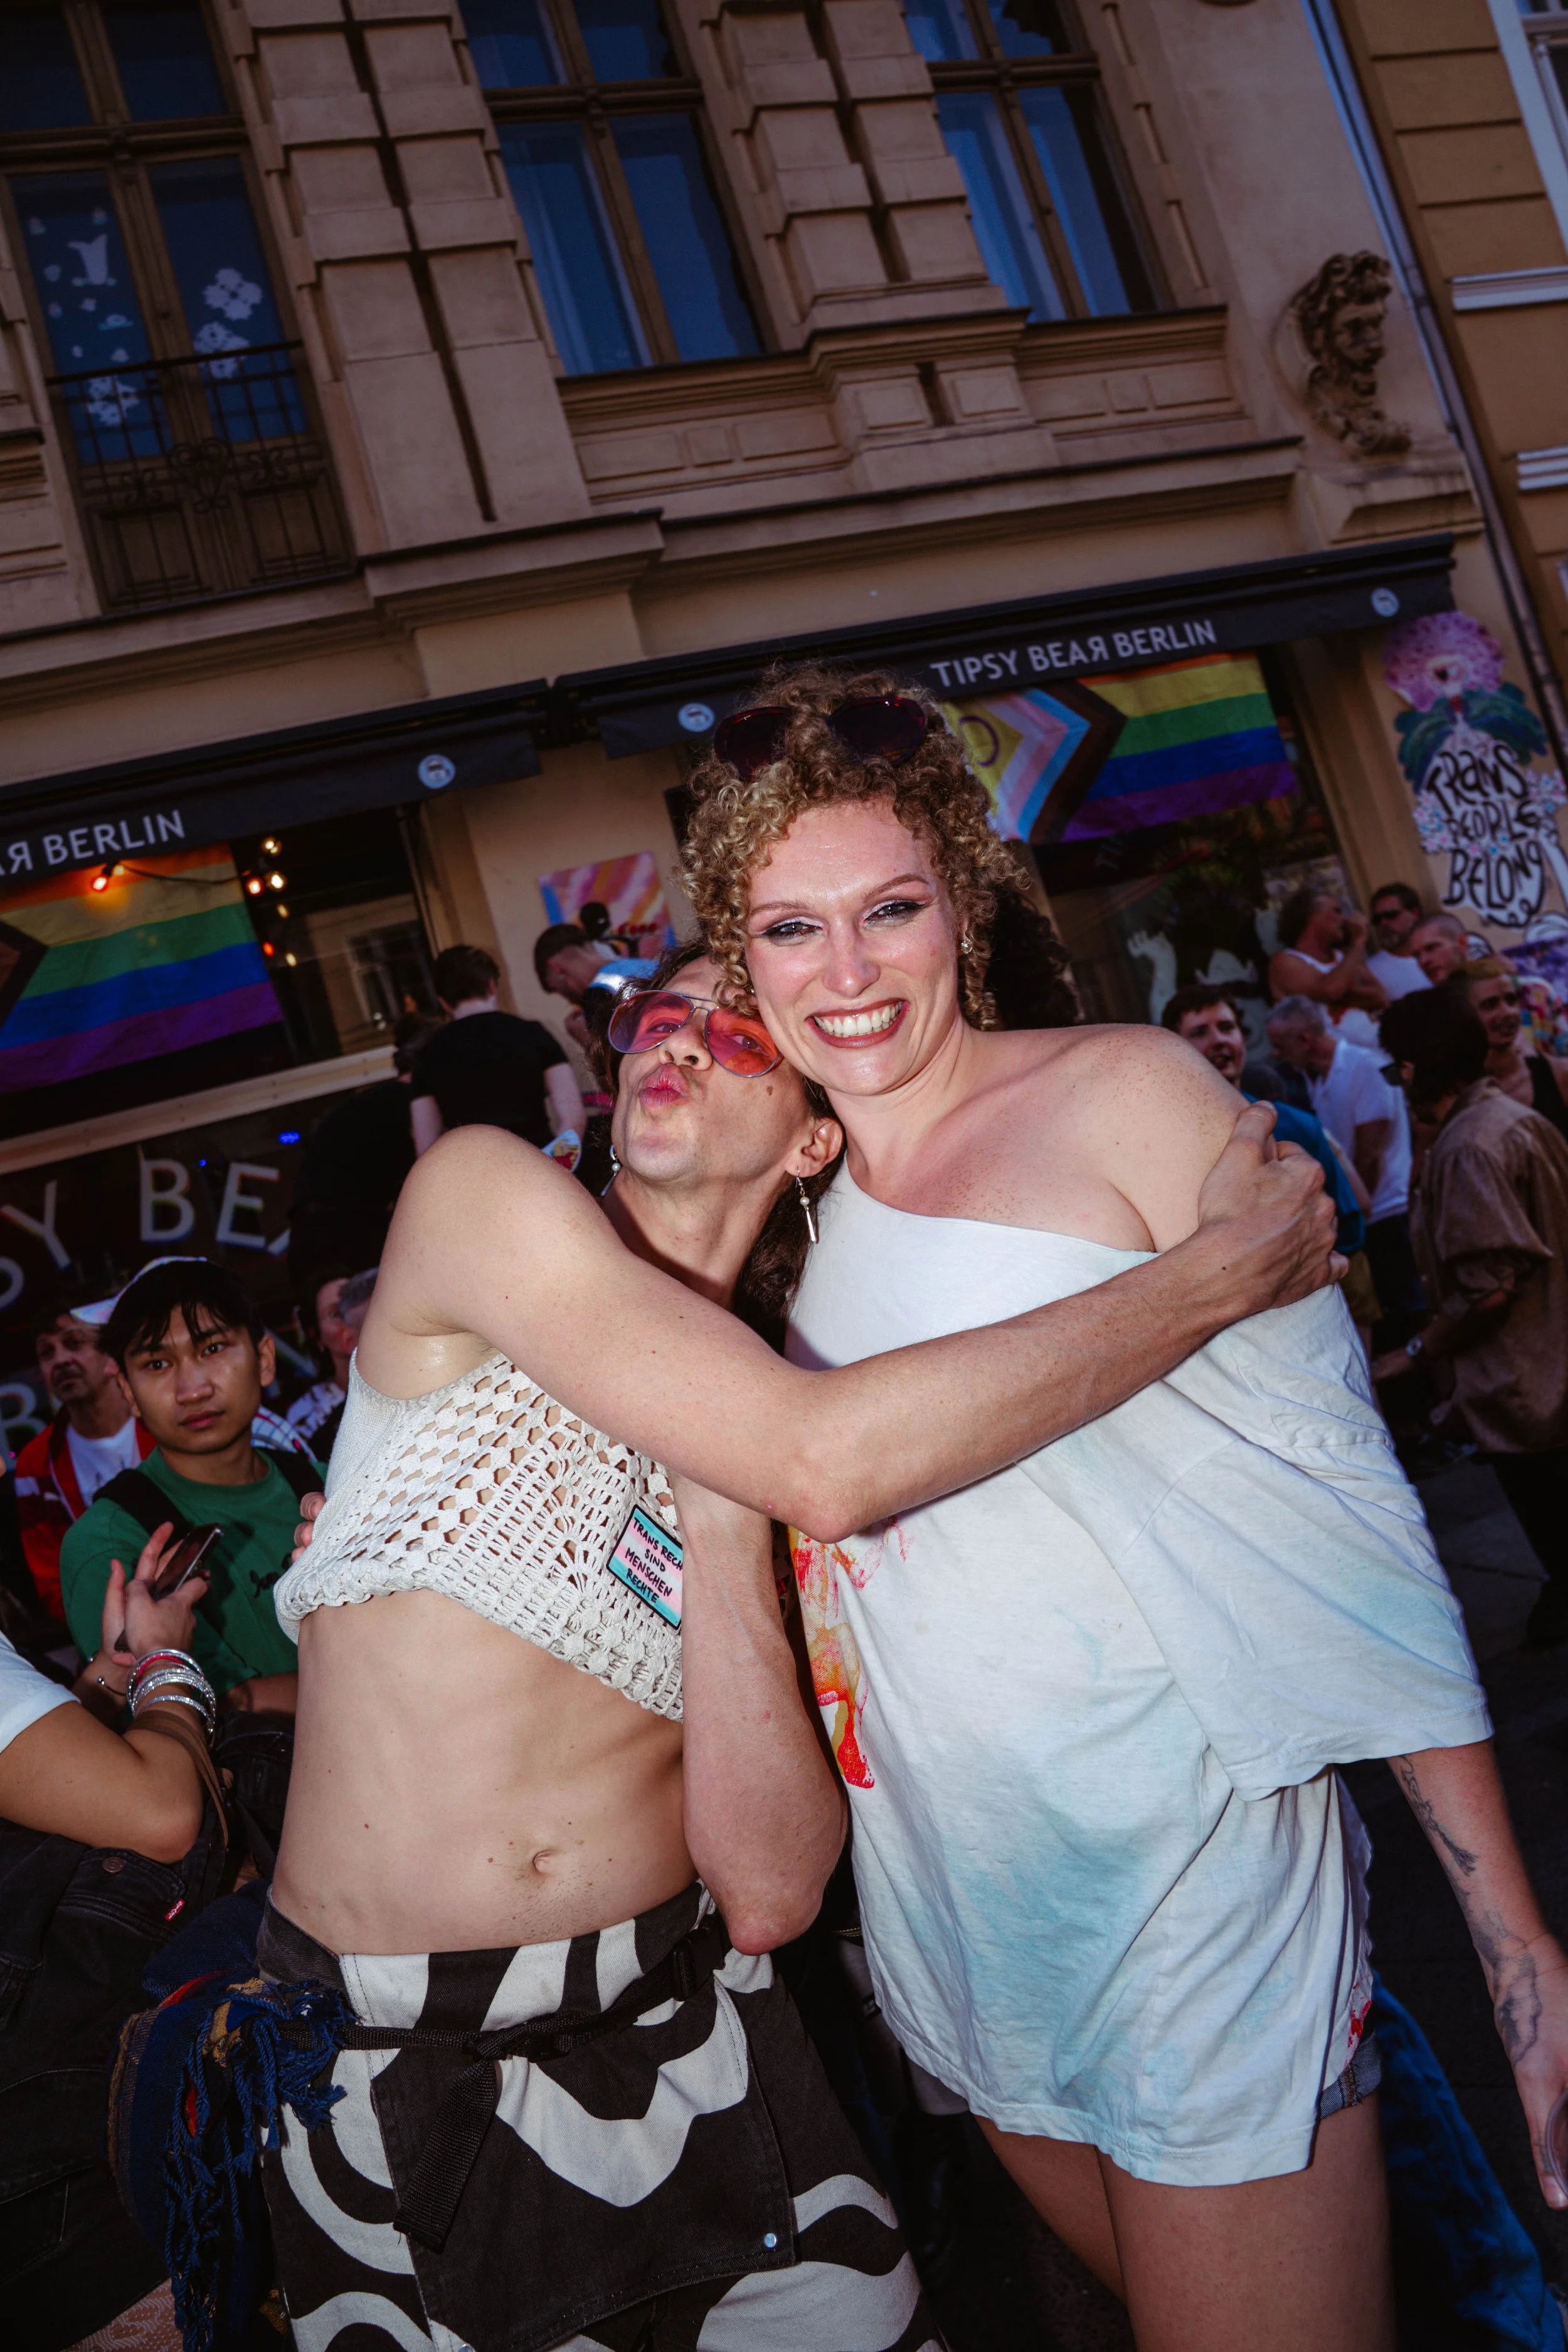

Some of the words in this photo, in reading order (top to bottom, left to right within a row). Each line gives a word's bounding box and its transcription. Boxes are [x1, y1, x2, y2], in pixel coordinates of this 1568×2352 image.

[930, 649, 1019, 688] TIPSY
[1111, 618, 1218, 659] BERLIN
[41, 808, 186, 866] BERLIN
[633, 1516, 659, 1550] TRANS
[625, 1546, 673, 1597] MENSCHEN
[644, 1548, 666, 1572] SIND
[625, 1567, 660, 1604] RECHTE
